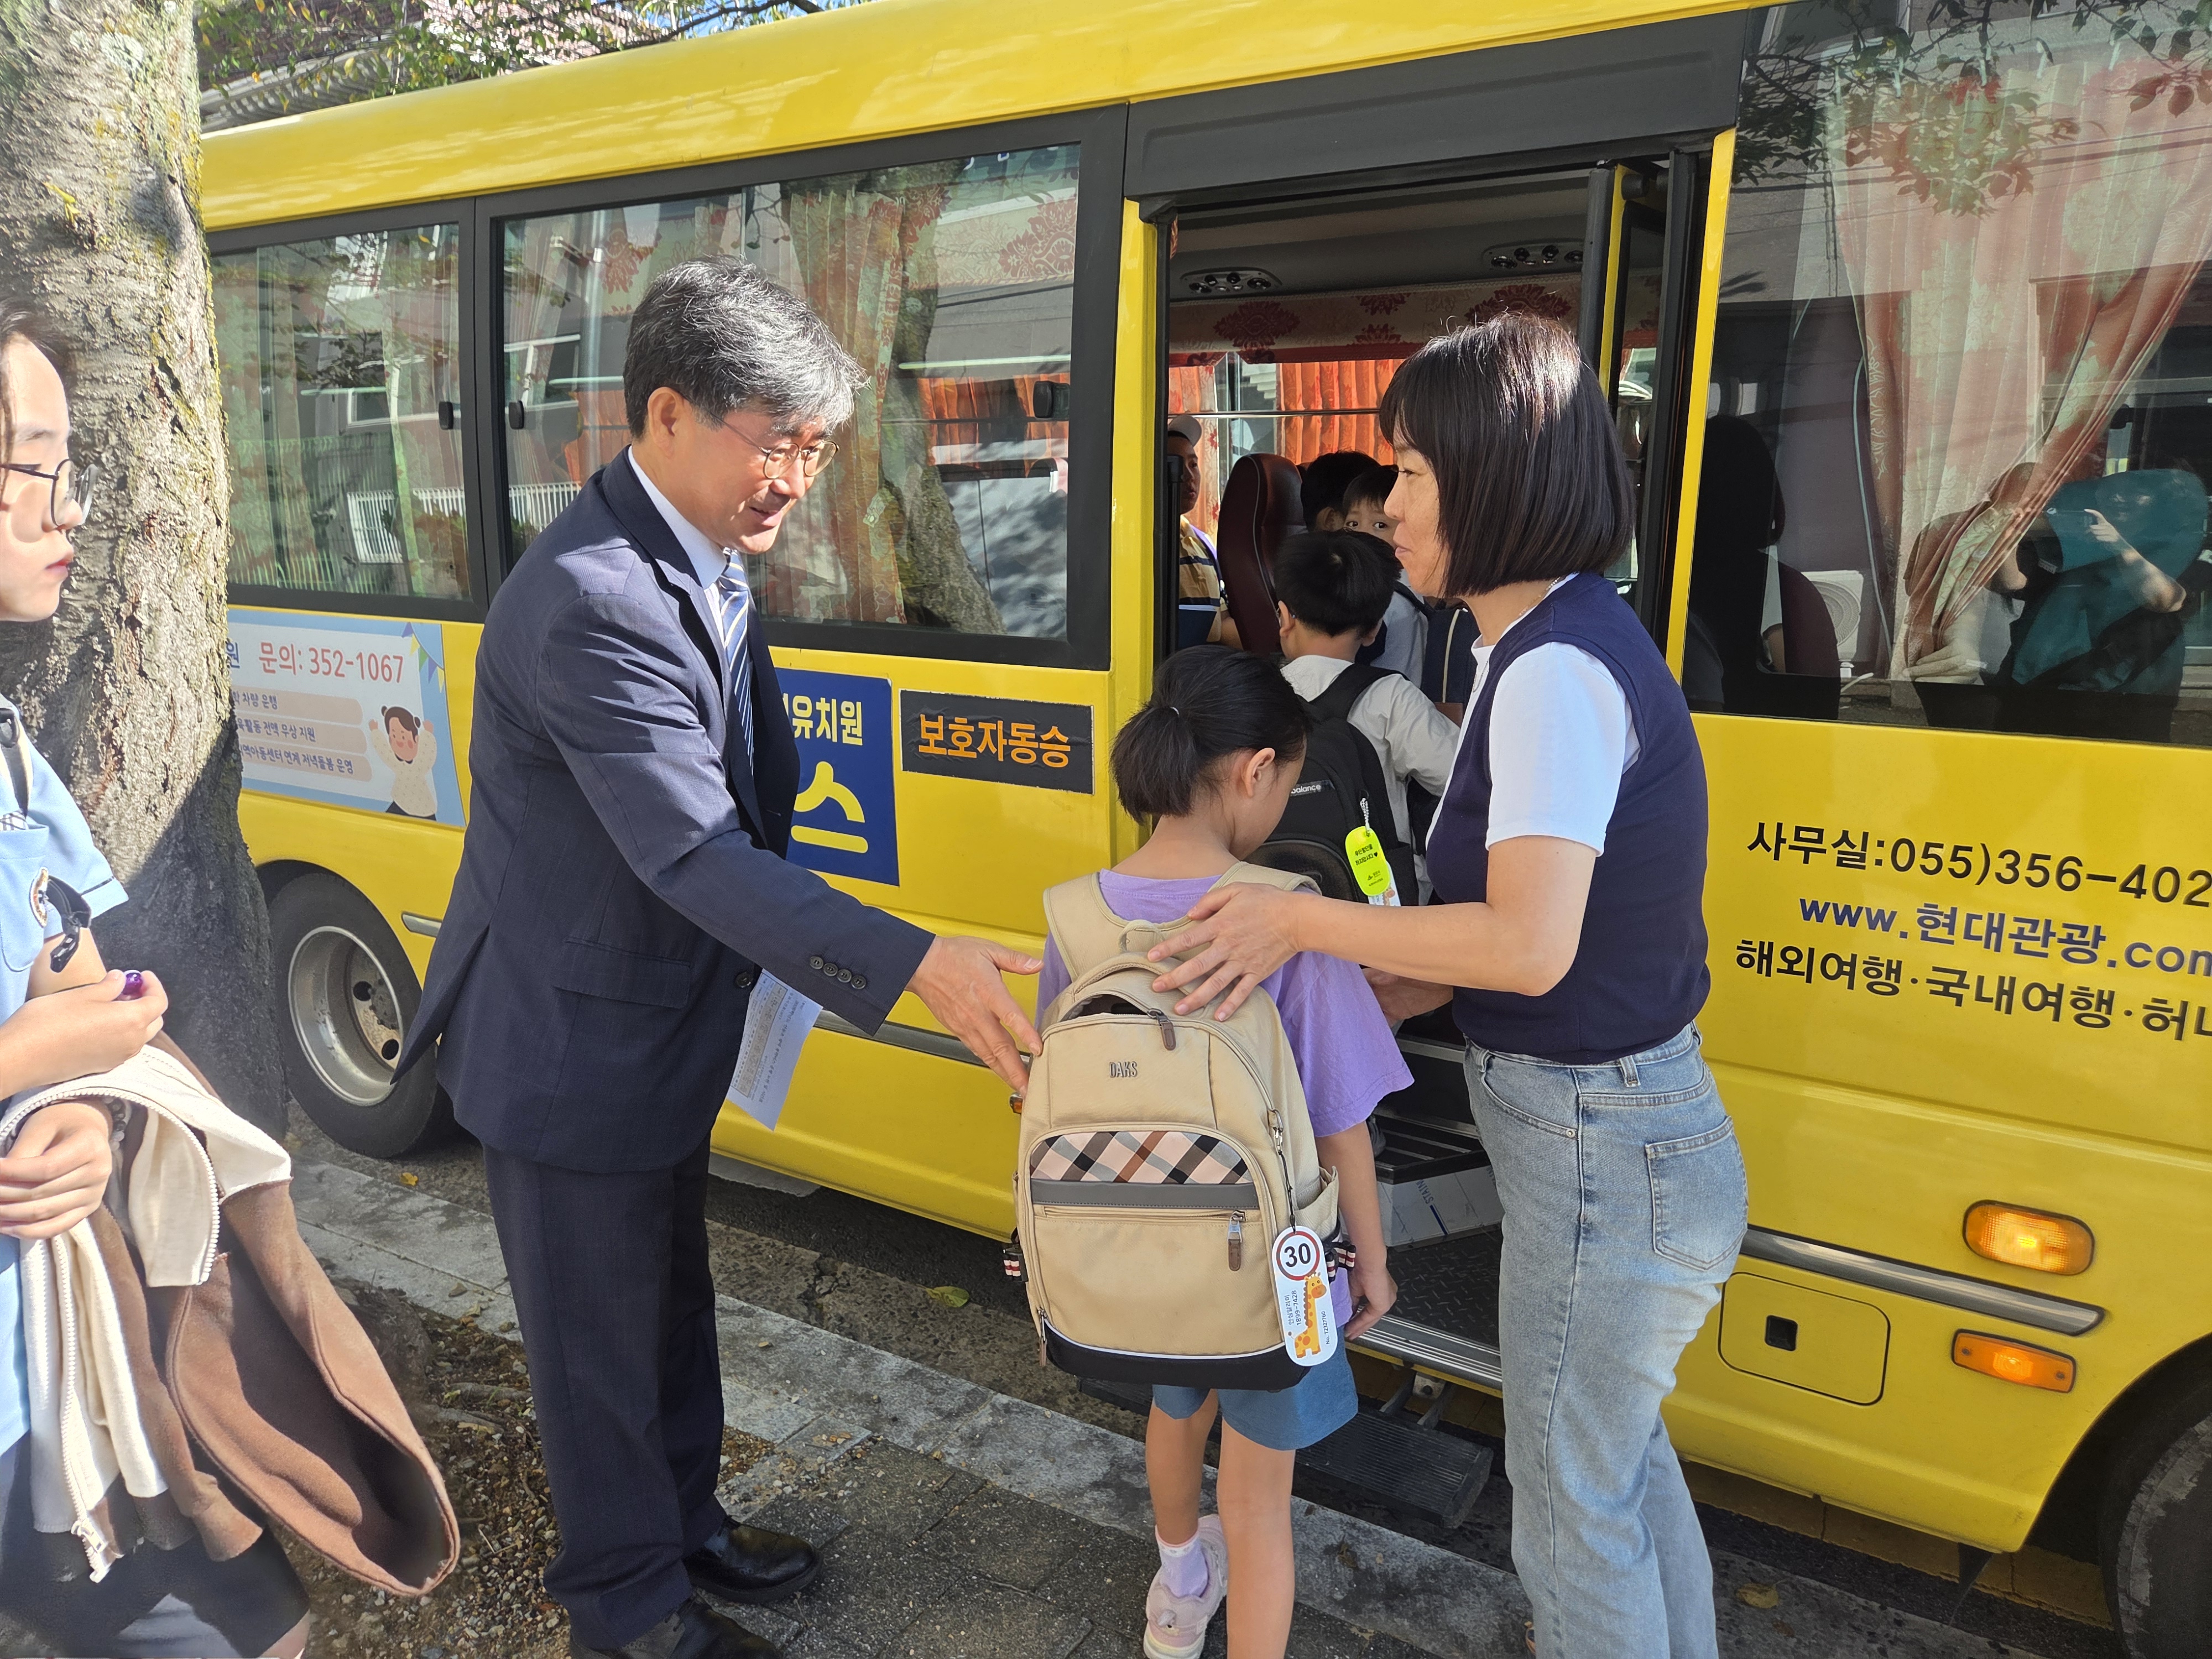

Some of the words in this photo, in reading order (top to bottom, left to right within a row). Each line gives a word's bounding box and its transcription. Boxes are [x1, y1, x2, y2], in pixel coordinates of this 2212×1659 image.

[259, 641, 303, 676] 문의:
[309, 646, 404, 684] 352-1067
[242, 691, 259, 708] 차량
[261, 693, 278, 710] 운행
[263, 721, 280, 737] 전액
[280, 723, 298, 740] 무상
[299, 726, 316, 743] 지원
[782, 692, 863, 746] 유치원
[918, 713, 1071, 768] 보호자동승
[239, 744, 283, 763] 역아동센터
[284, 750, 301, 766] 연계
[301, 753, 335, 772] 저녁돌봄
[336, 758, 354, 775] 운영
[1109, 1061, 1138, 1078] DAKS
[1284, 1243, 1311, 1267] 30
[1284, 1295, 1295, 1326] 안심알리미
[1291, 1290, 1302, 1326] 1899-7428
